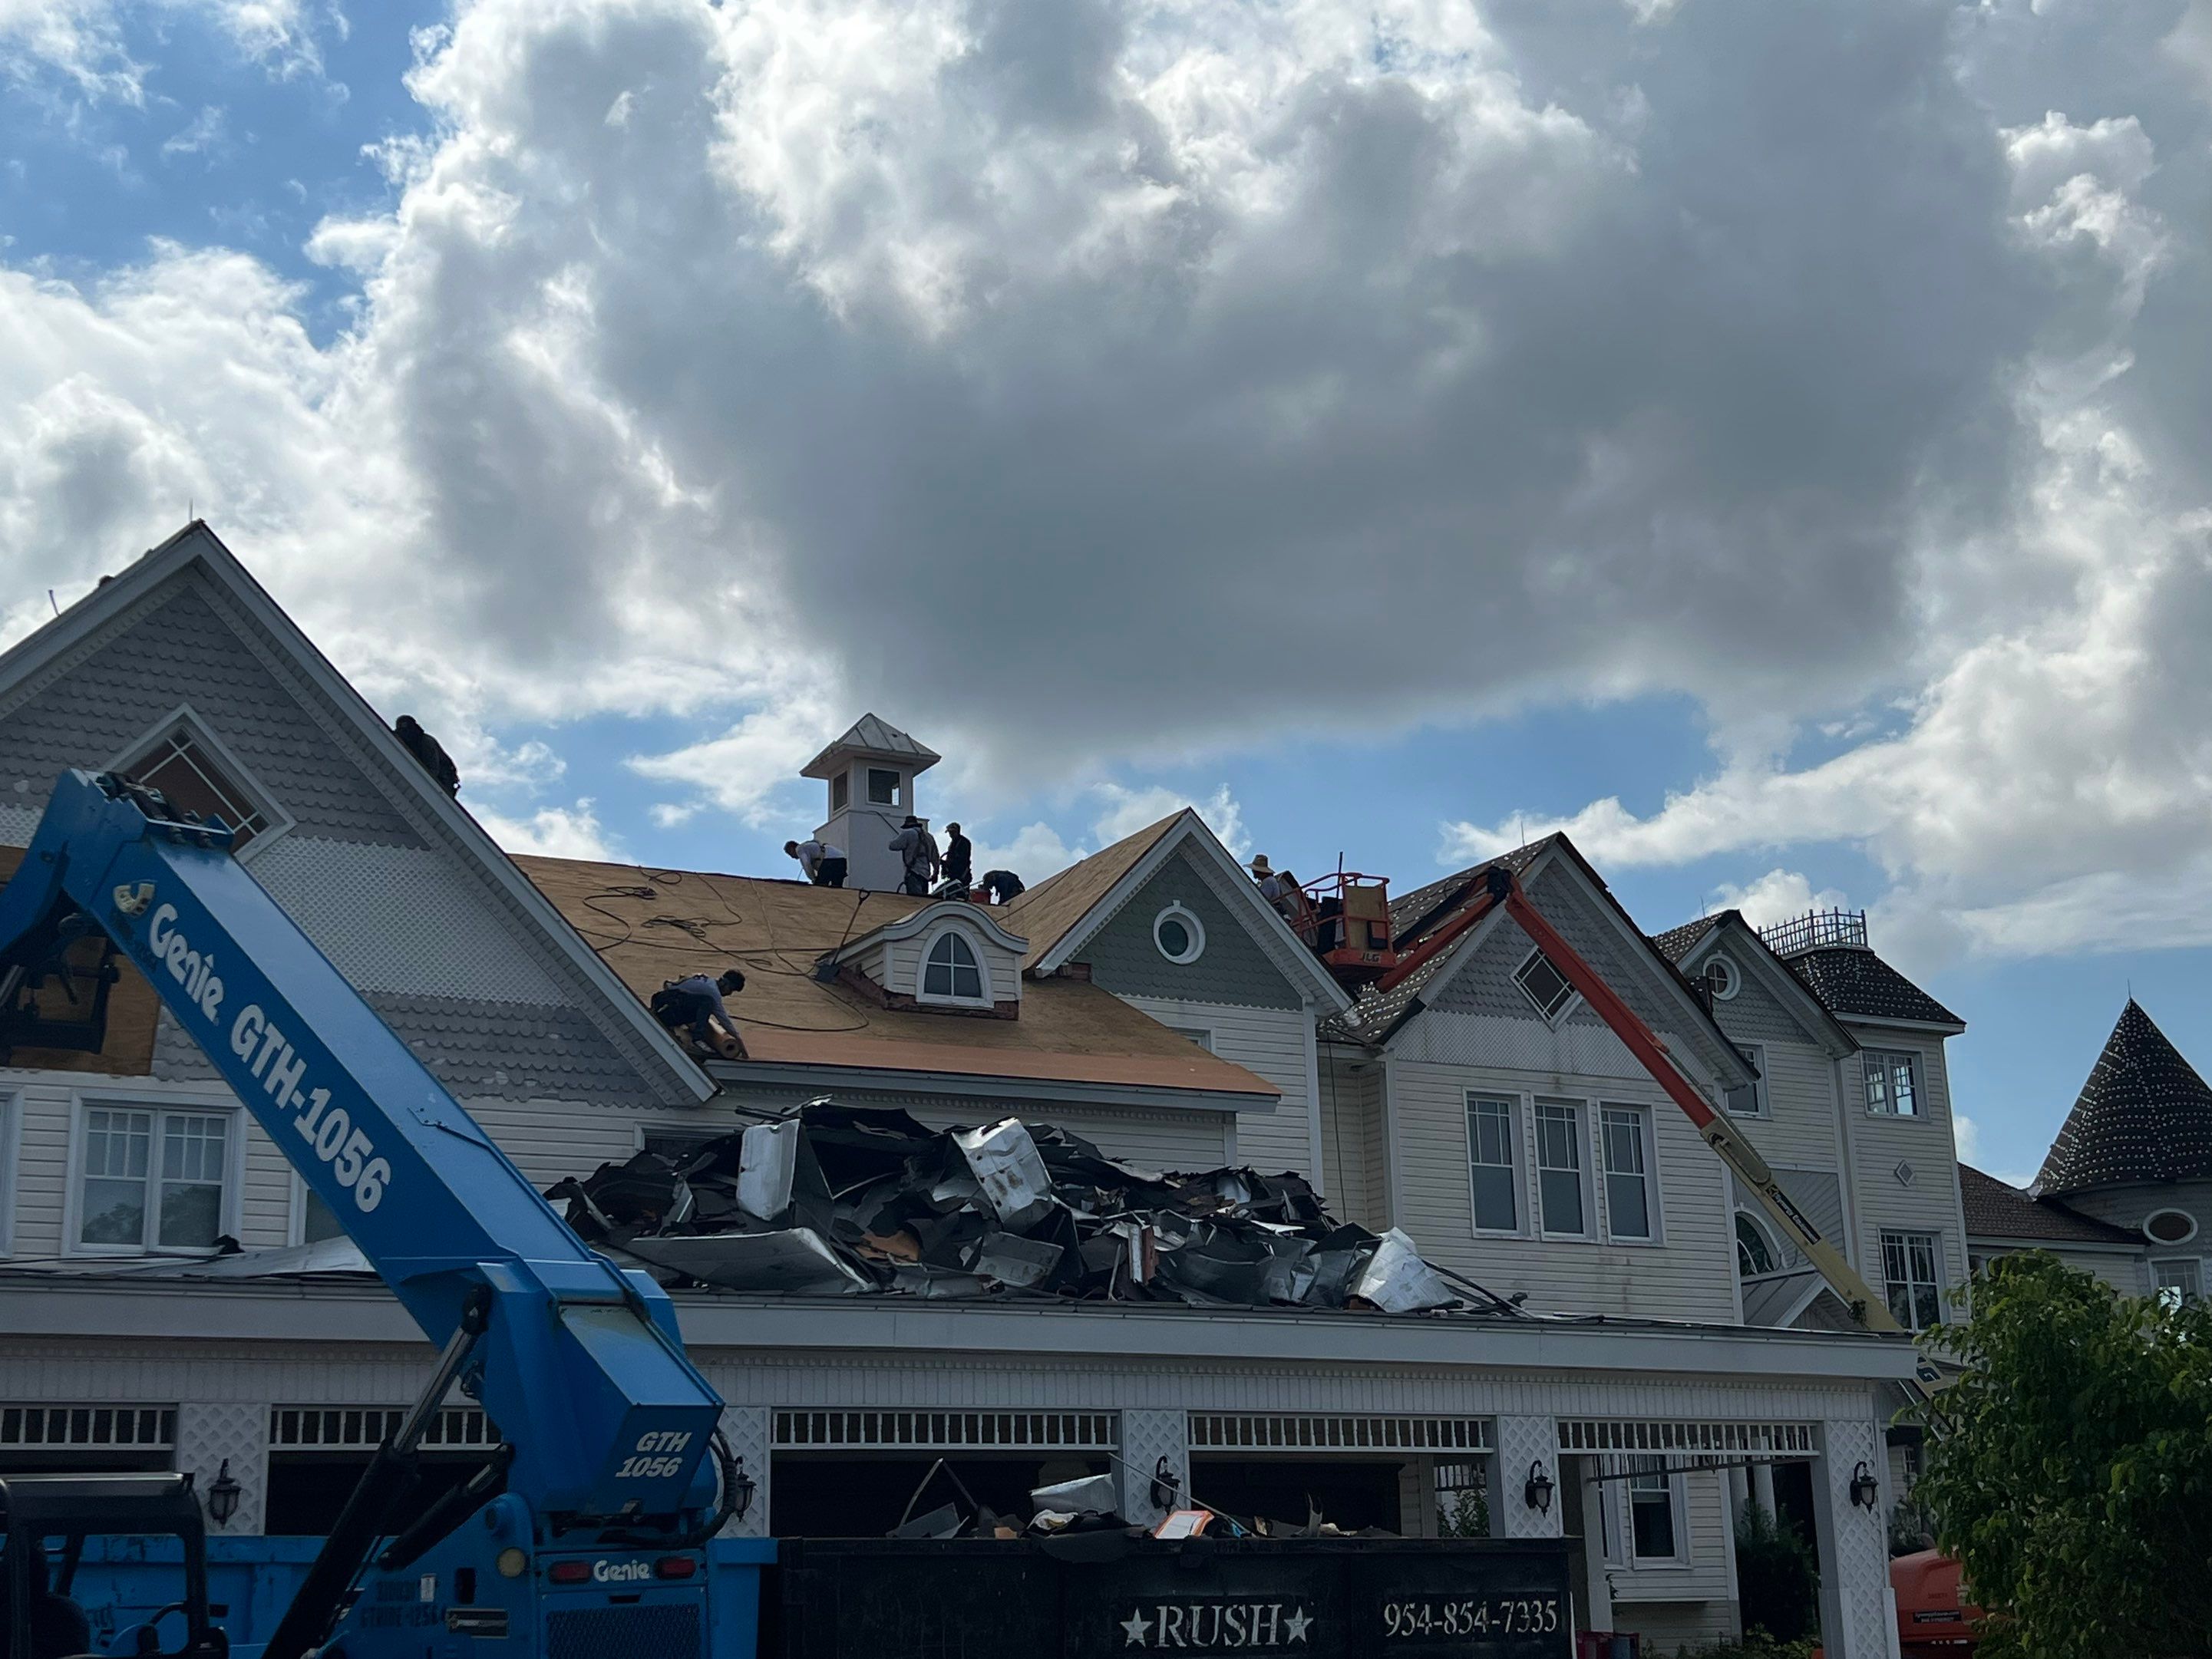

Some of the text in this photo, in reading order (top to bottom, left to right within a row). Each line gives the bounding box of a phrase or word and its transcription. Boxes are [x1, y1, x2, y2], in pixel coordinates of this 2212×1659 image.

[150, 903, 391, 1212] Genie GTH-1056
[636, 1432, 692, 1453] GTH
[615, 1456, 682, 1478] 1056
[593, 1558, 650, 1582] Genie
[1154, 1604, 1283, 1648] RUSH
[1384, 1600, 1557, 1638] 954-854-7335
